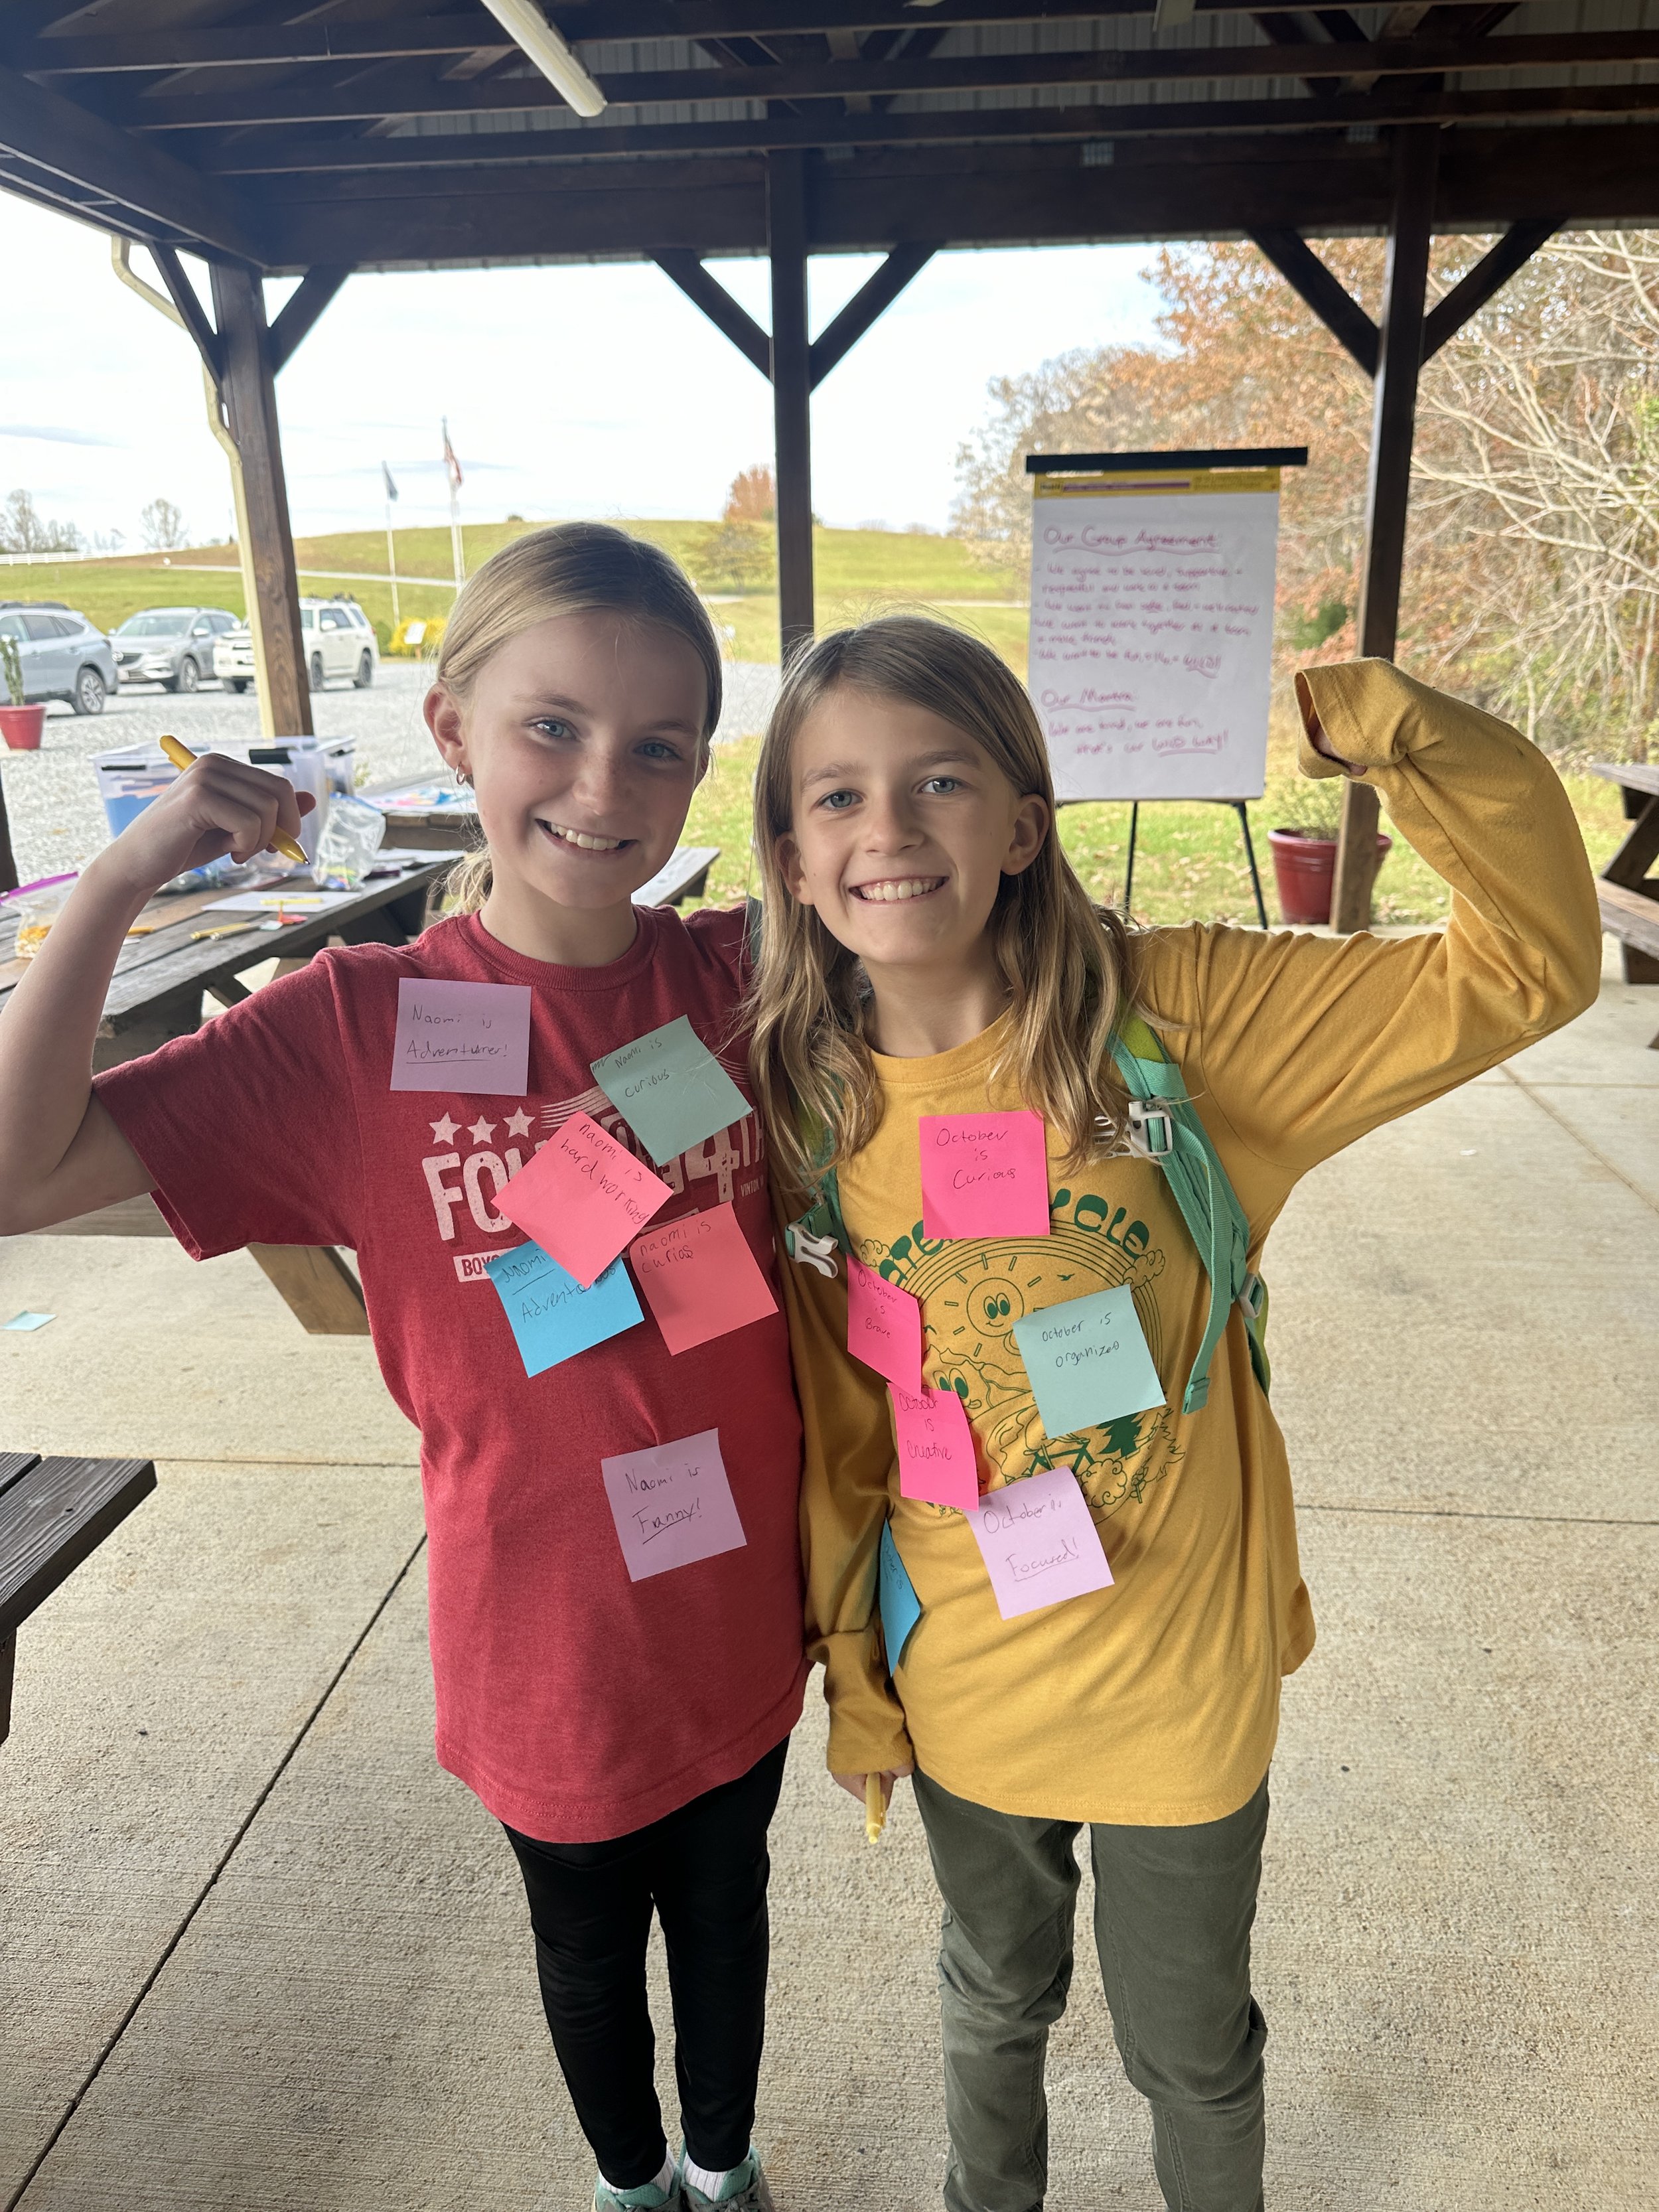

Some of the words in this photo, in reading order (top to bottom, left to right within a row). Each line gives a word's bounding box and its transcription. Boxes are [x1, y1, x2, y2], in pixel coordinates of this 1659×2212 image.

[1044, 525, 1074, 544] Our
[1081, 524, 1127, 548] Group
[1041, 689, 1070, 707] Our
[413, 1004, 461, 1024] Naomi
[482, 1013, 492, 1029] is
[649, 1037, 662, 1049] is
[937, 1128, 1008, 1146] October
[561, 1139, 598, 1180] hard
[974, 1148, 987, 1161] is
[954, 1169, 1016, 1189] Curious
[696, 1220, 711, 1234] is
[858, 1269, 897, 1303] October
[865, 1317, 891, 1338] Brave
[626, 1468, 673, 1493] Naomi
[684, 1463, 700, 1477] is
[983, 1503, 1046, 1534] October
[1005, 1537, 1079, 1576] Focused!
